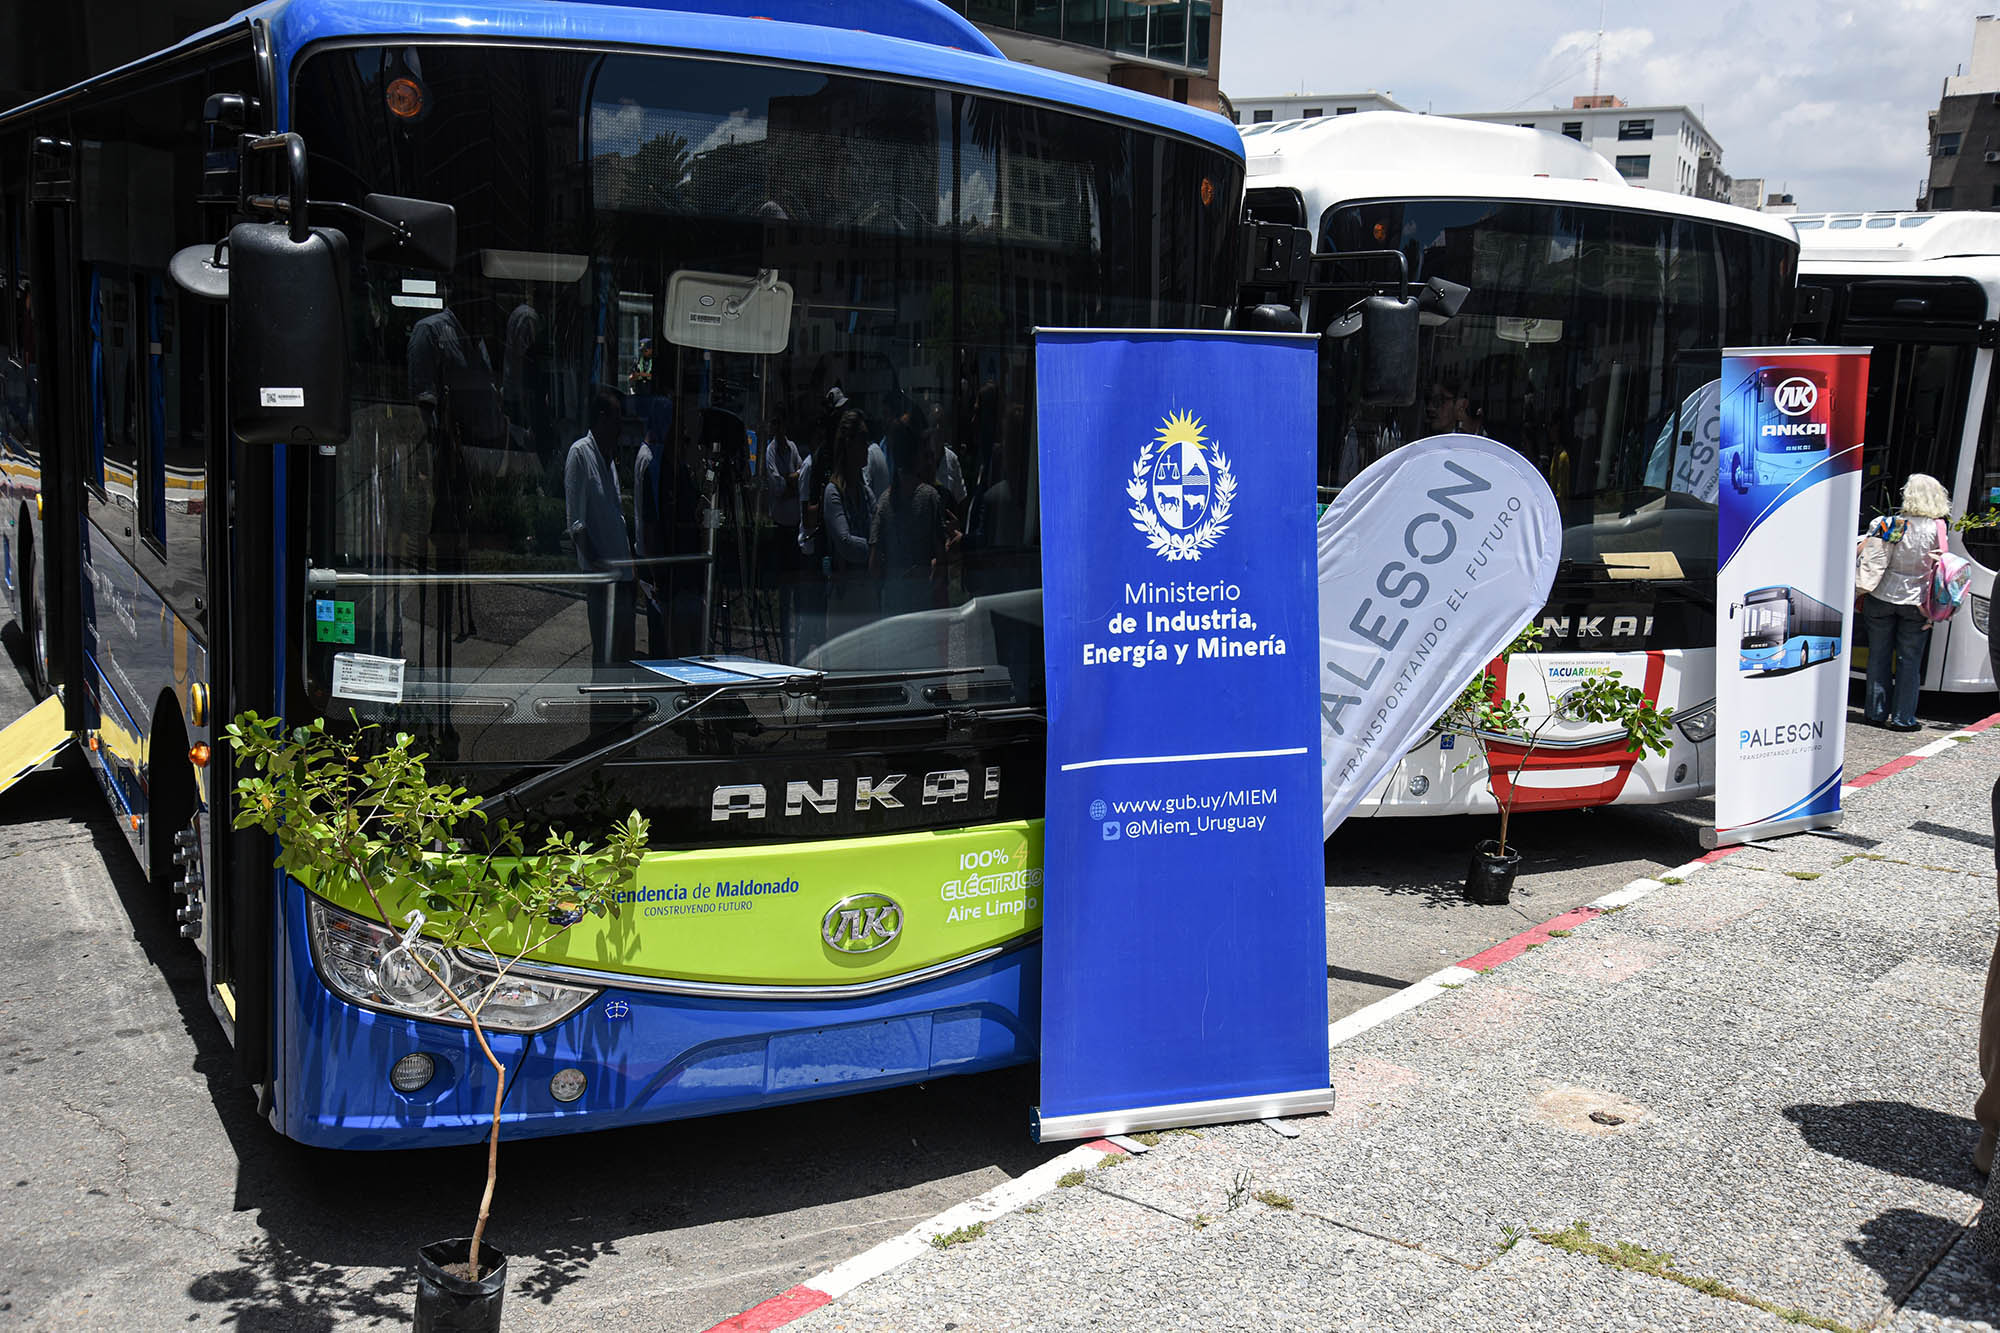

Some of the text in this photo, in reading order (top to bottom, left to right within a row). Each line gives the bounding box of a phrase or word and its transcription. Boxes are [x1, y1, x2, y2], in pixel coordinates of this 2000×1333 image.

[1761, 423, 1827, 438] ANKAI
[1785, 444, 1812, 452] ANKAI
[1124, 579, 1241, 605] Ministerio
[1320, 460, 1492, 736] ALESON
[1107, 607, 1258, 635] de Industria,
[1540, 616, 1655, 638] NKAI
[1082, 633, 1287, 668] Energía y Minería
[1339, 496, 1522, 783] TRANSPORTANDO EL FUTURO
[1739, 720, 1824, 750] PALESON
[711, 766, 1001, 821] ANKAI
[1112, 788, 1278, 814] www.gub.uy/MIEM
[1125, 814, 1267, 839] @Miem_Uruguay
[959, 847, 1009, 871] 100%
[692, 883, 711, 899] de
[715, 876, 800, 898] Maldonado
[940, 867, 1043, 901] ELÉCTRICO
[643, 900, 753, 917] CONSTRUYENDO FUTURO
[945, 895, 1038, 923] Aire Limpio
